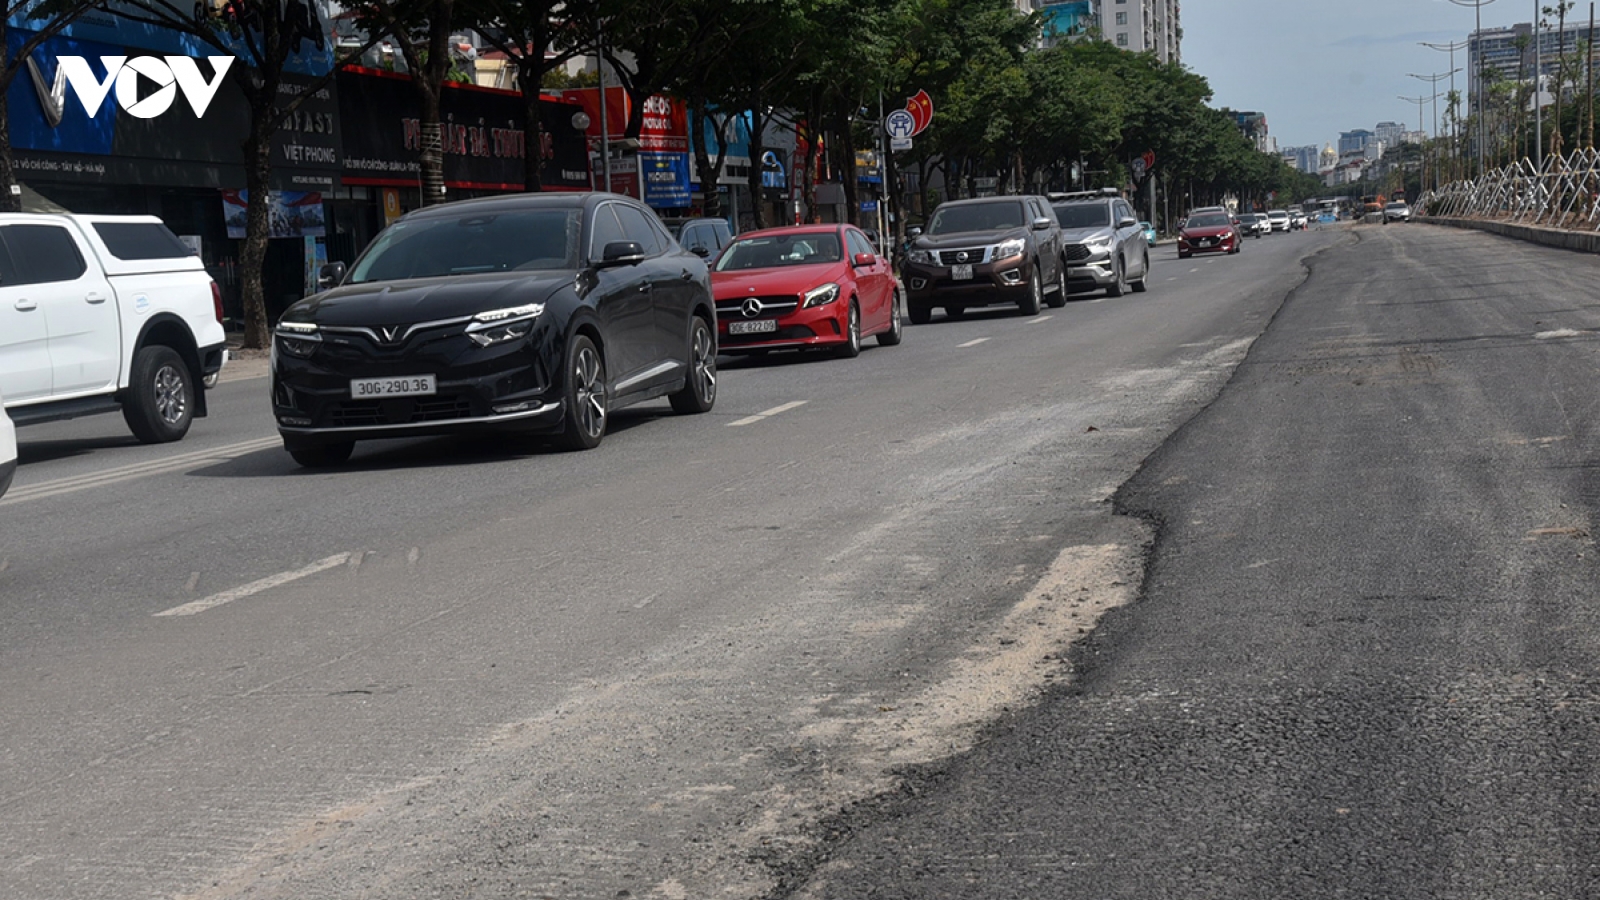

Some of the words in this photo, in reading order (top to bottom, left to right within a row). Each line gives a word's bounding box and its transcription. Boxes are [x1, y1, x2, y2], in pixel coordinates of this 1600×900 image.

[283, 141, 303, 164] VIỆT
[305, 147, 335, 163] PHONG
[358, 378, 429, 395] 30G-290.36
